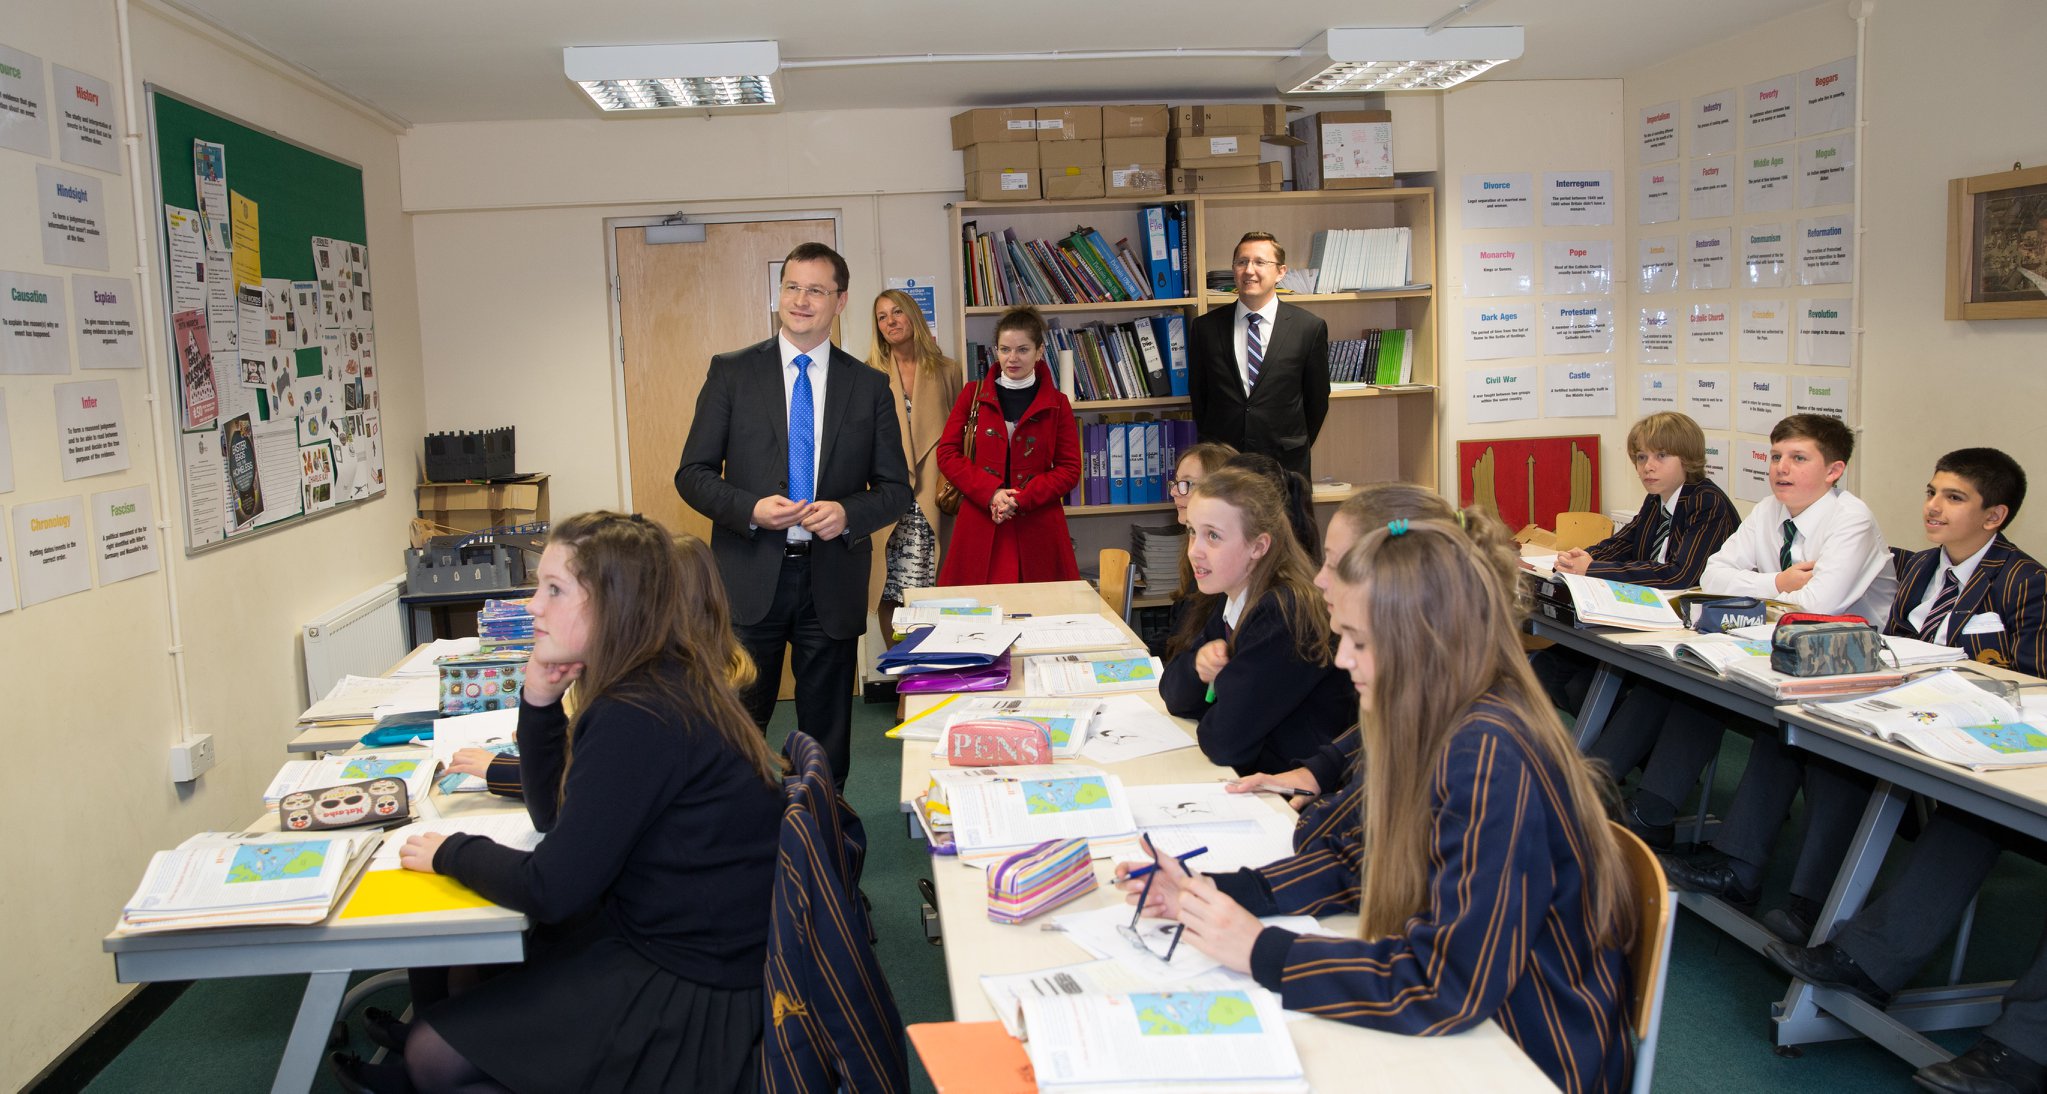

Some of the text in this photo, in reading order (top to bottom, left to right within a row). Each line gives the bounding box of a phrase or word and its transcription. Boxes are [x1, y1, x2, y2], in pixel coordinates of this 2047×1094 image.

[0, 63, 21, 79] ource
[1815, 73, 1839, 87] Beggars
[75, 85, 99, 106] History
[1759, 89, 1779, 101] Poverty
[1703, 102, 1722, 113] Industry
[1771, 156, 1785, 168] Ages
[1702, 167, 1720, 177] Factory
[1483, 181, 1511, 190] Divorce
[1556, 179, 1601, 189] Interregnum
[56, 183, 88, 204] Hindsight
[1807, 226, 1842, 238] Reformation
[1695, 239, 1721, 249] Restoration
[1750, 234, 1781, 245] Communism
[1480, 250, 1516, 260] Monarchy
[1569, 249, 1587, 258] Pope
[11, 287, 48, 304] Causation
[93, 290, 117, 306] Explain
[1481, 312, 1518, 322] Dark Ages
[1560, 307, 1598, 317] Protestant
[1807, 309, 1839, 319] Revolution
[1485, 375, 1518, 385] Civil War
[1568, 371, 1591, 380] Castle
[1698, 379, 1716, 390] Slavery
[1753, 381, 1770, 392] Feudal
[1808, 385, 1832, 397] Peasant
[82, 396, 98, 409] Infer
[1752, 450, 1768, 463] Treaty
[111, 502, 136, 517] Fascism
[31, 514, 71, 532] Chronology
[1720, 613, 1764, 628] ANIMAL
[953, 733, 1039, 764] PENS
